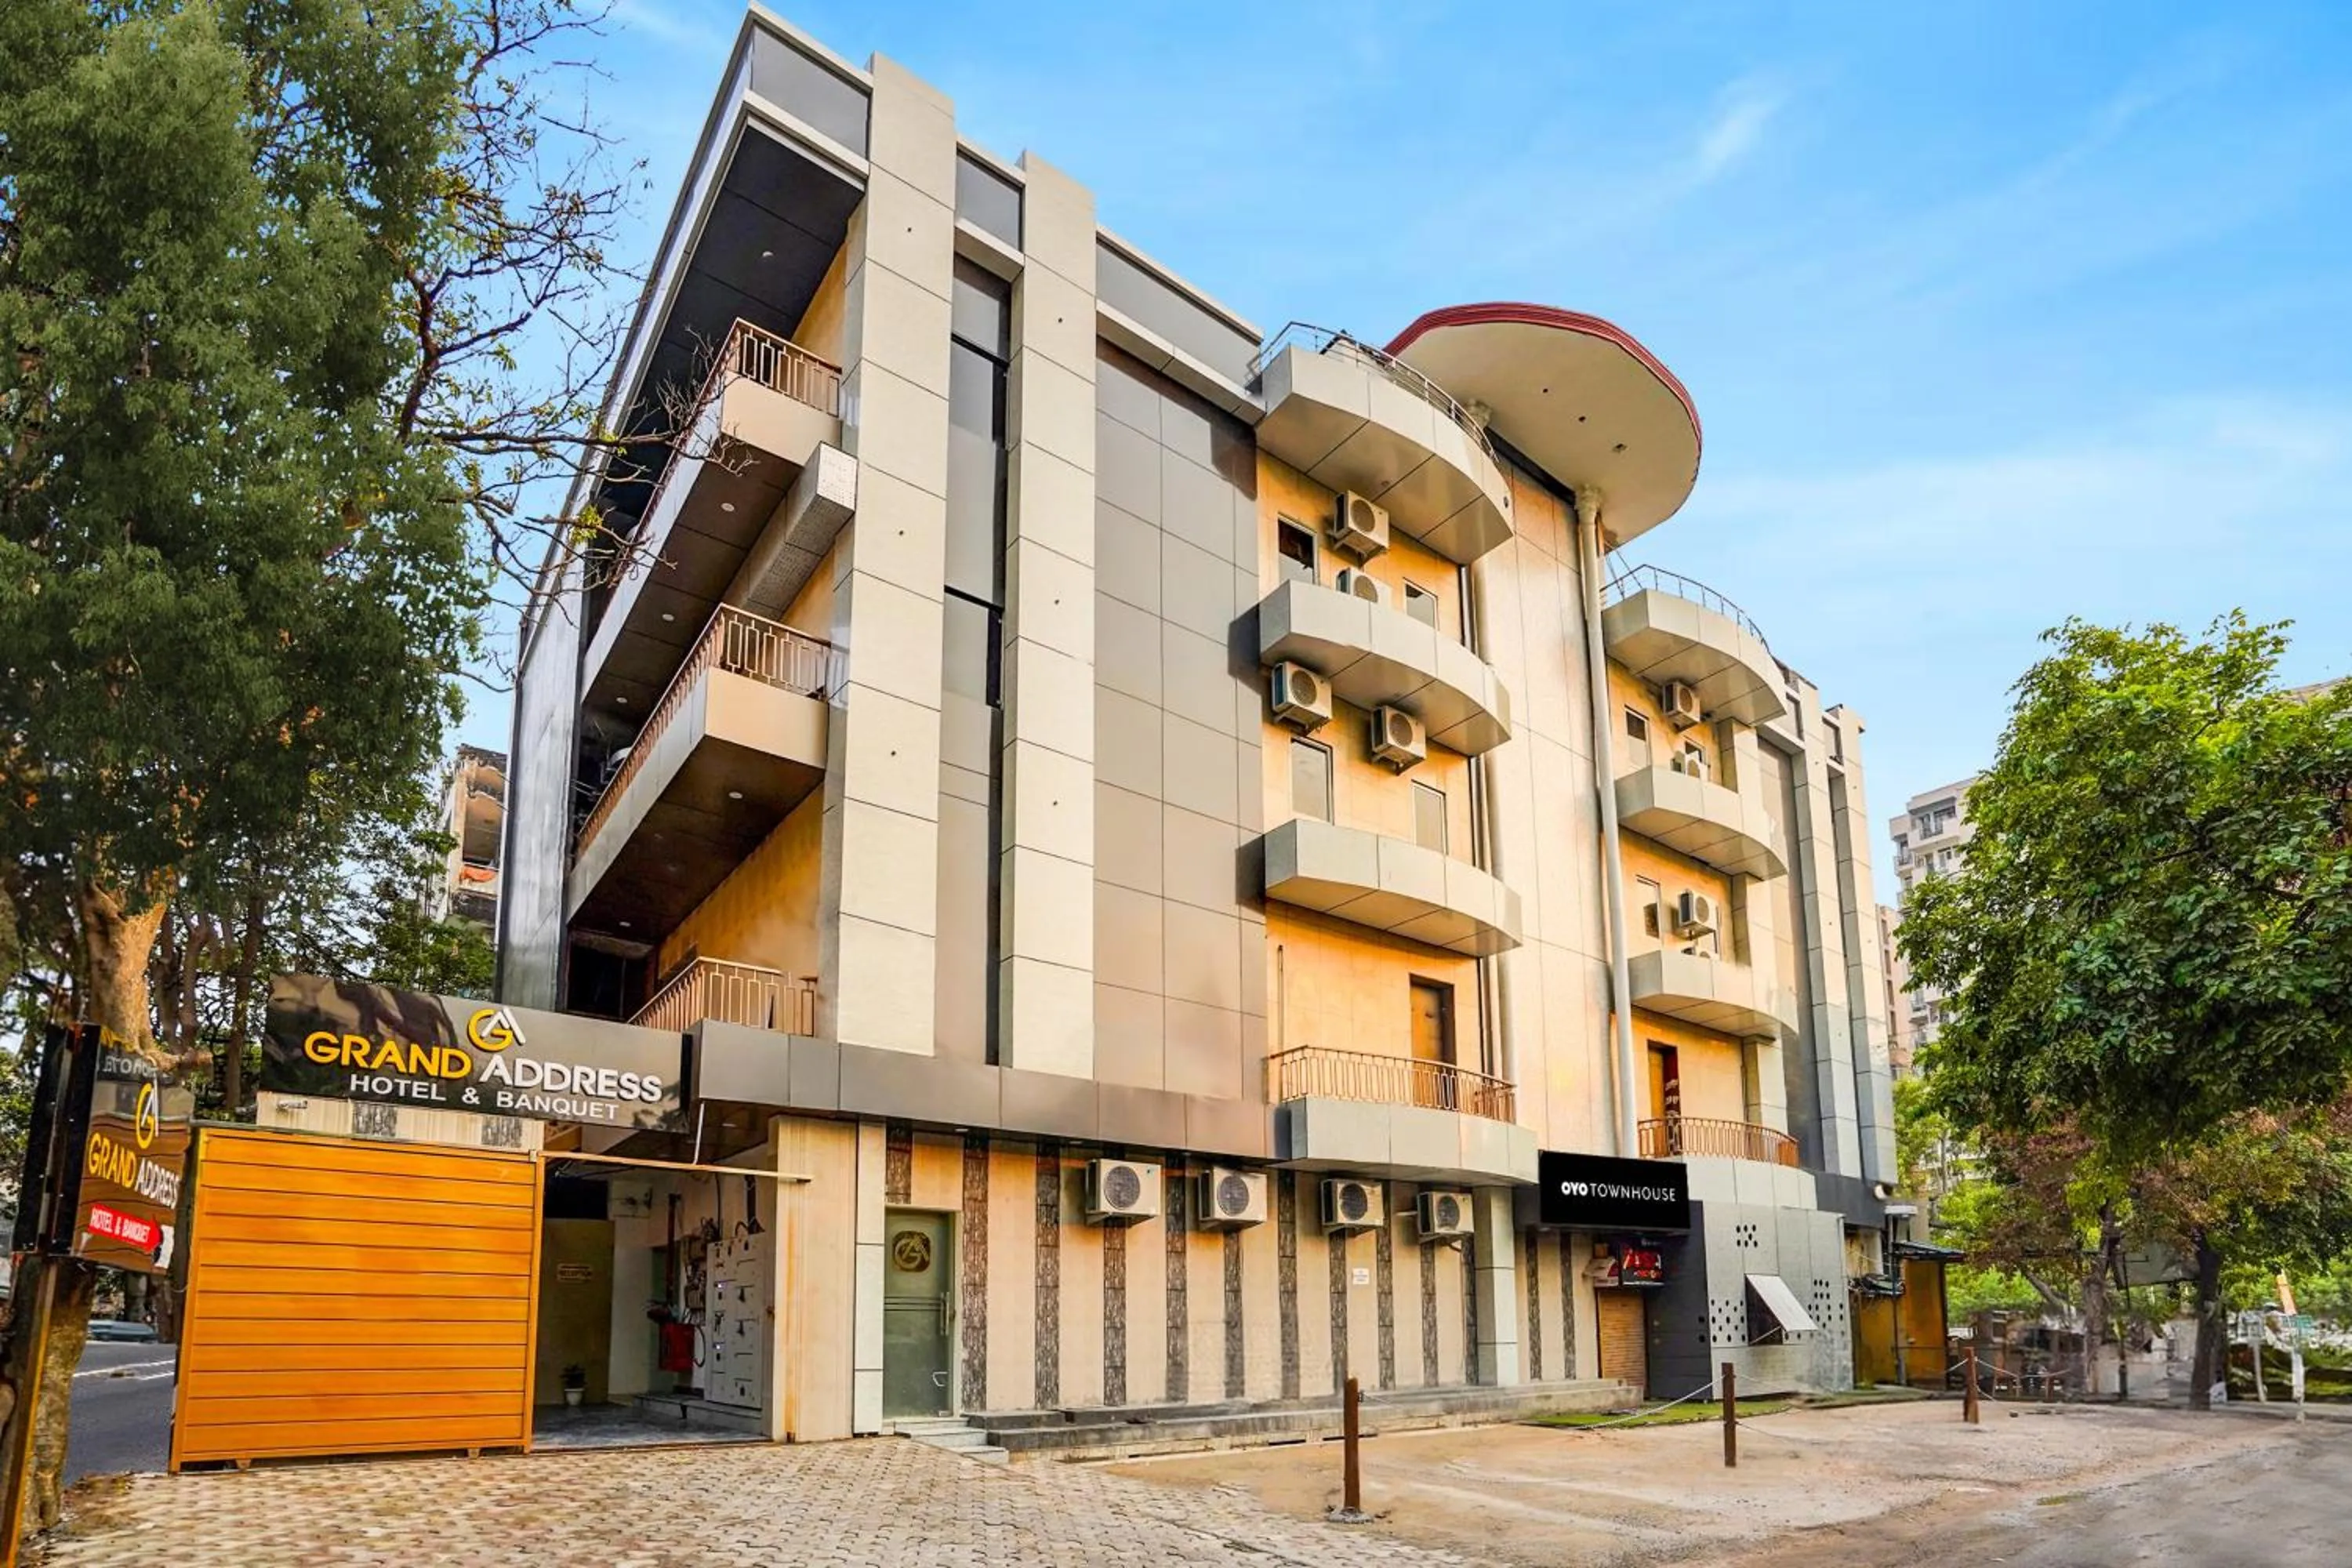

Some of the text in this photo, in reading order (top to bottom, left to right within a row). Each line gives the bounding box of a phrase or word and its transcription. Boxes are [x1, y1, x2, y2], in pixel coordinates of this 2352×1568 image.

[303, 1031, 662, 1102] GRAND ADDRESS
[350, 1073, 619, 1120] HOTEL & BANQUET
[89, 1132, 180, 1210] GRAND ADDRESS
[1561, 1181, 1677, 1202] OYO TOWNHOUSE
